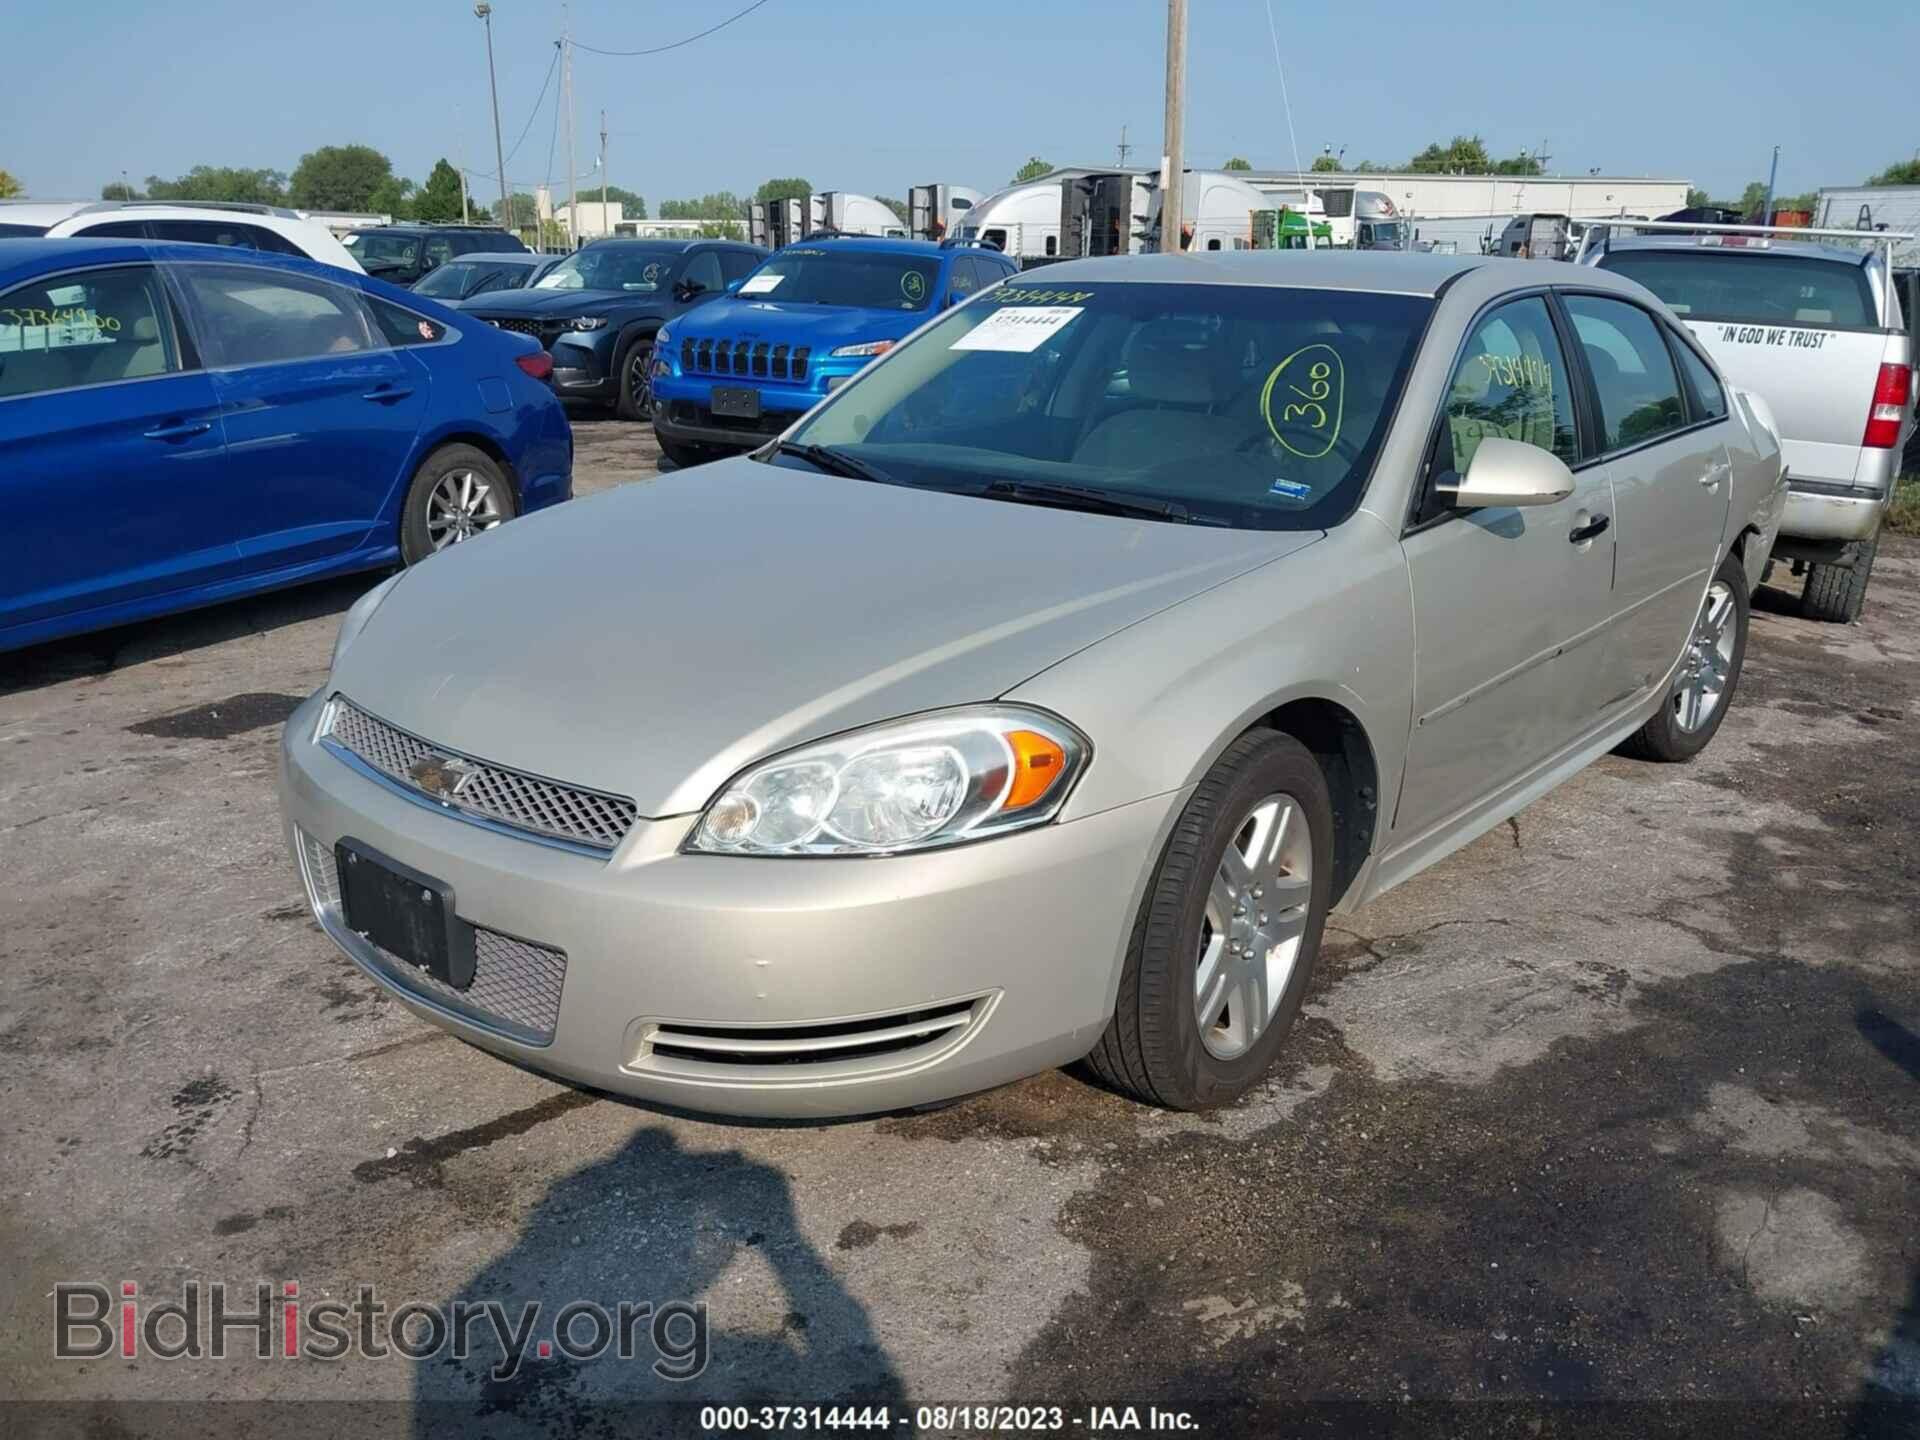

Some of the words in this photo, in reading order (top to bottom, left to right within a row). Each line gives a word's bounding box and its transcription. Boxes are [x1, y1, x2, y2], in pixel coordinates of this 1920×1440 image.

[1738, 327, 1764, 344] GOD
[1766, 328, 1786, 346] WE
[1283, 361, 1331, 428] 360
